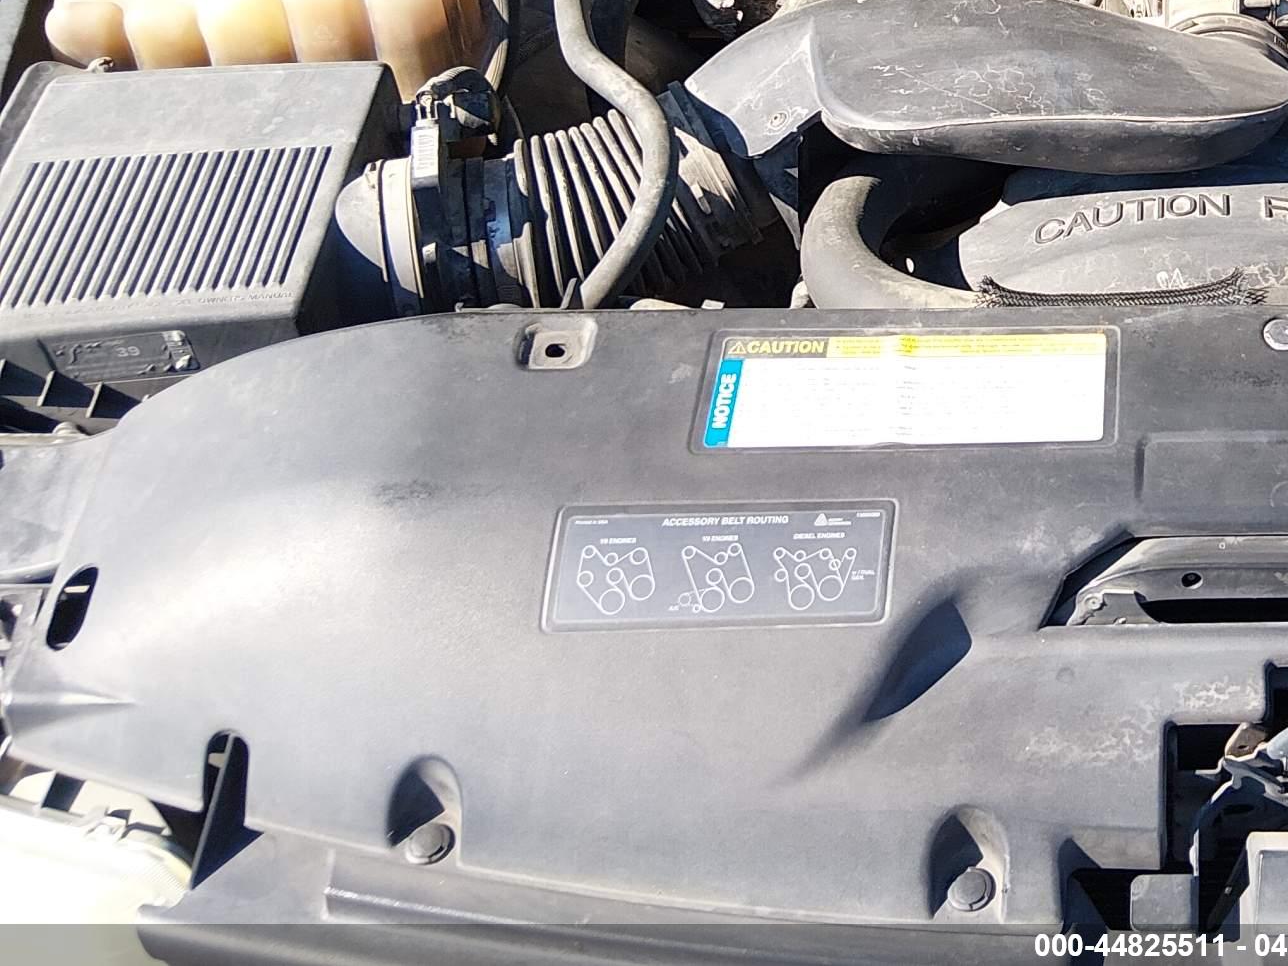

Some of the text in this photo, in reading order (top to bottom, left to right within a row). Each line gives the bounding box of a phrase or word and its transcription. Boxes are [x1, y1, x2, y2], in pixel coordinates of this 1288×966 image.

[1033, 192, 1231, 246] CAUTION
[114, 344, 141, 358] 39
[746, 340, 825, 355] CAUTION
[711, 373, 738, 430] NOTICE
[661, 514, 789, 527] ACCESSORY BELT ROUTING
